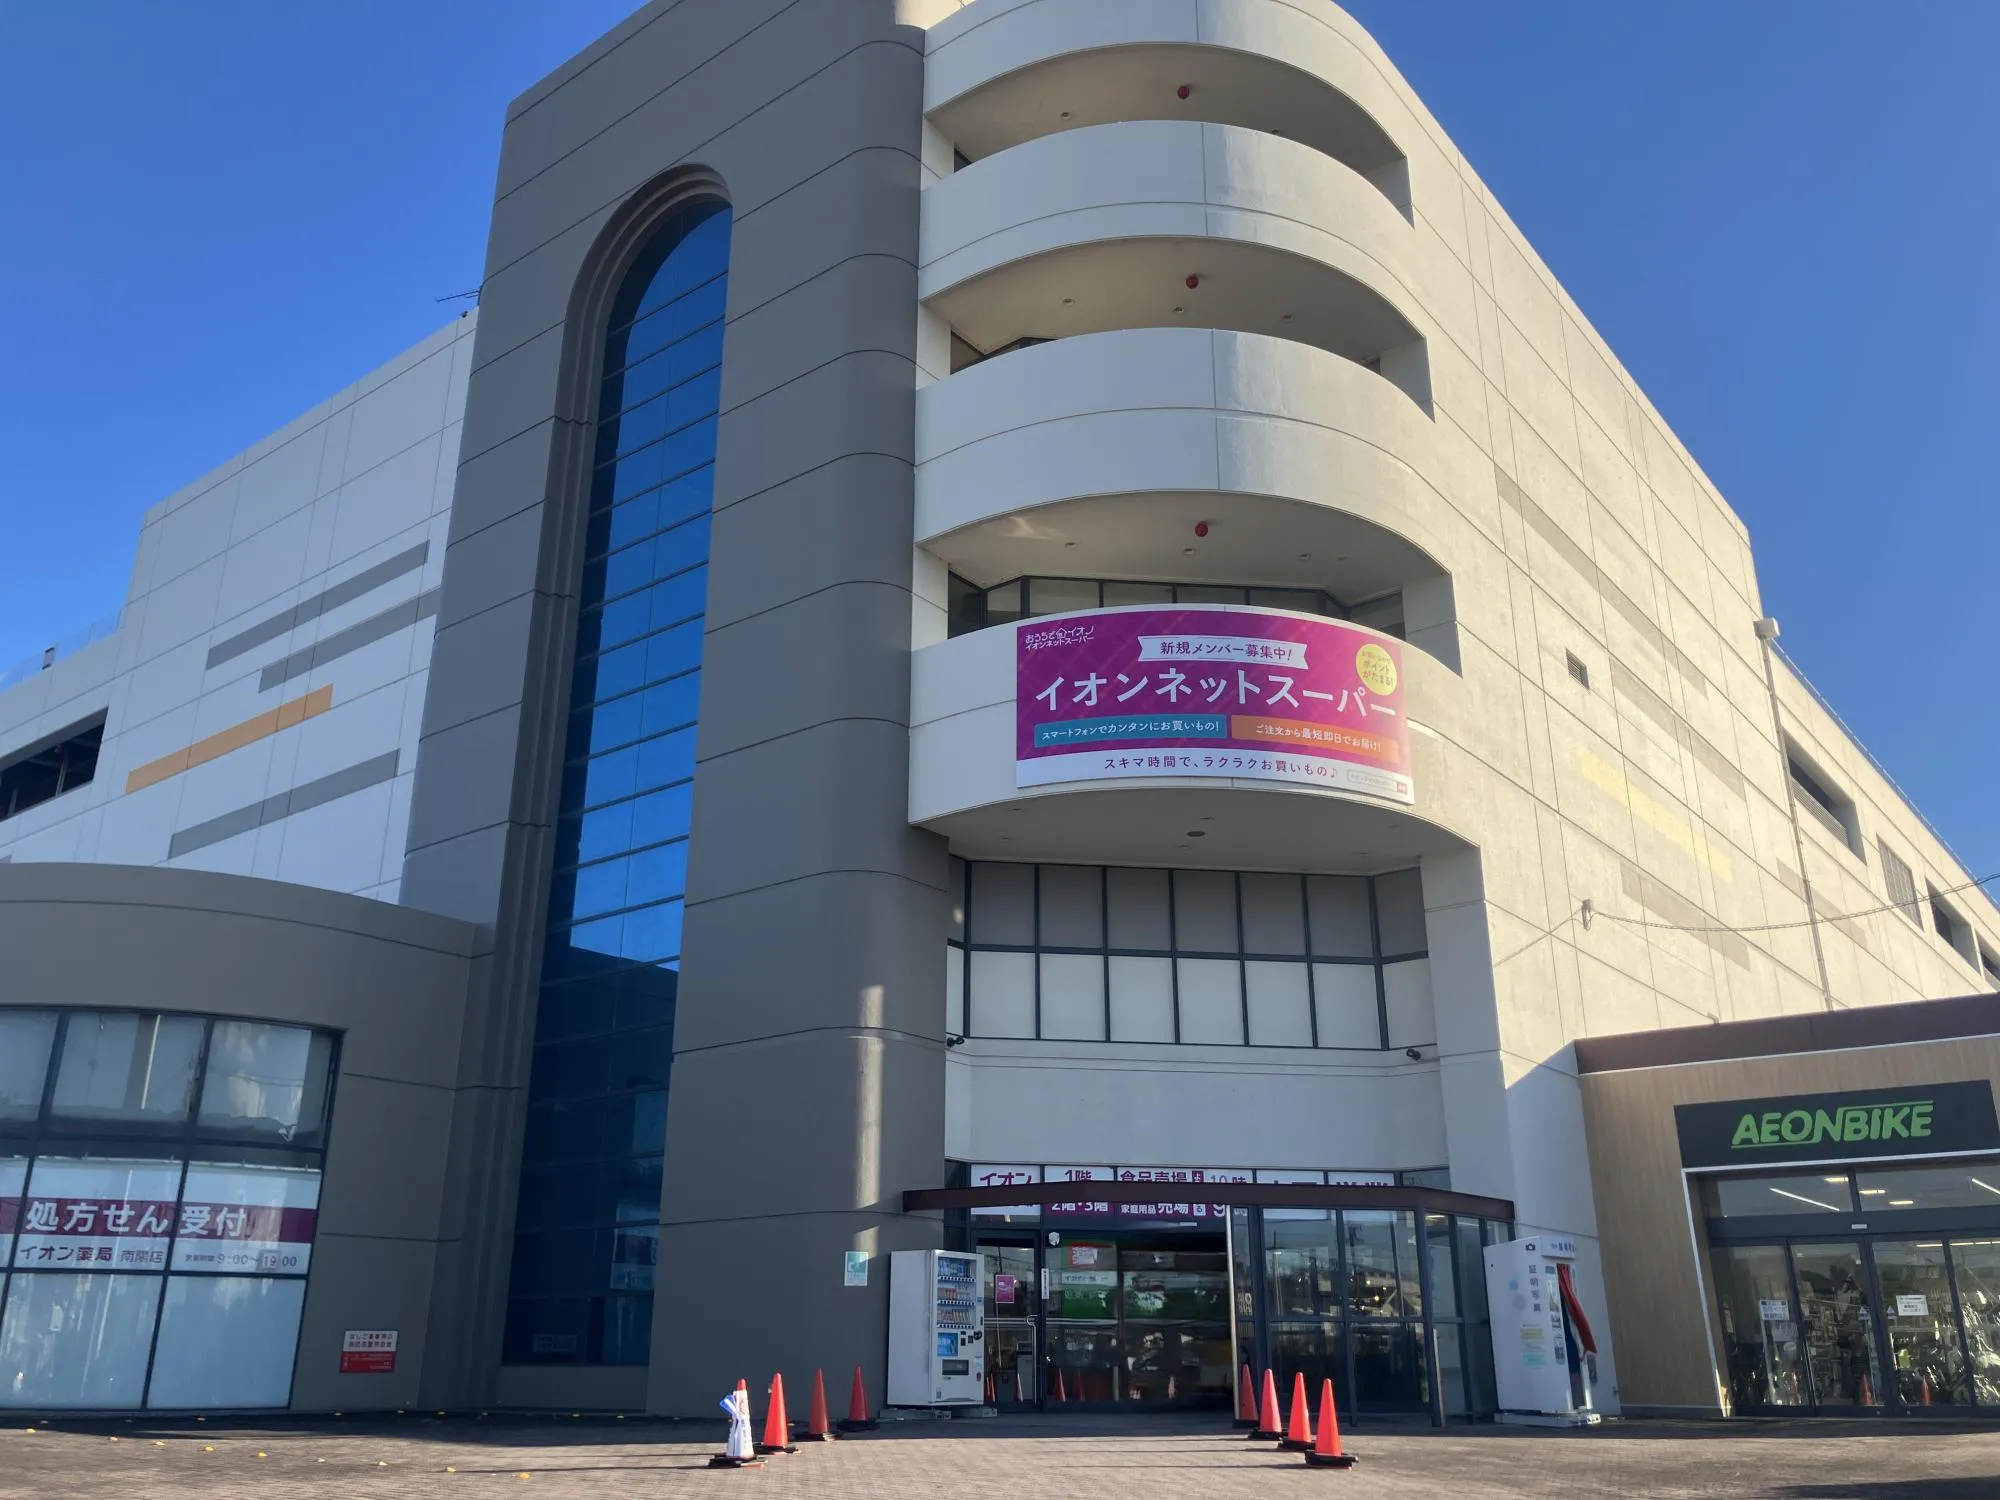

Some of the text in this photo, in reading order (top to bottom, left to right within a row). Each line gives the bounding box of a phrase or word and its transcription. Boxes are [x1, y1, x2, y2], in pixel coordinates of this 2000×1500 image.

[1025, 636, 1095, 651] イオンネットスーパー
[1160, 641, 1293, 661] 新規メンバー募集中!
[1035, 667, 1396, 717] イオンネットスーパー
[1041, 720, 1219, 741] スマートフォンでカンタンにお買いもの!
[1255, 724, 1382, 752] ご注文から最短即日でお届け!
[1731, 1101, 1934, 1148] AEONBIKE
[20, 1246, 113, 1261] イオン薬局
